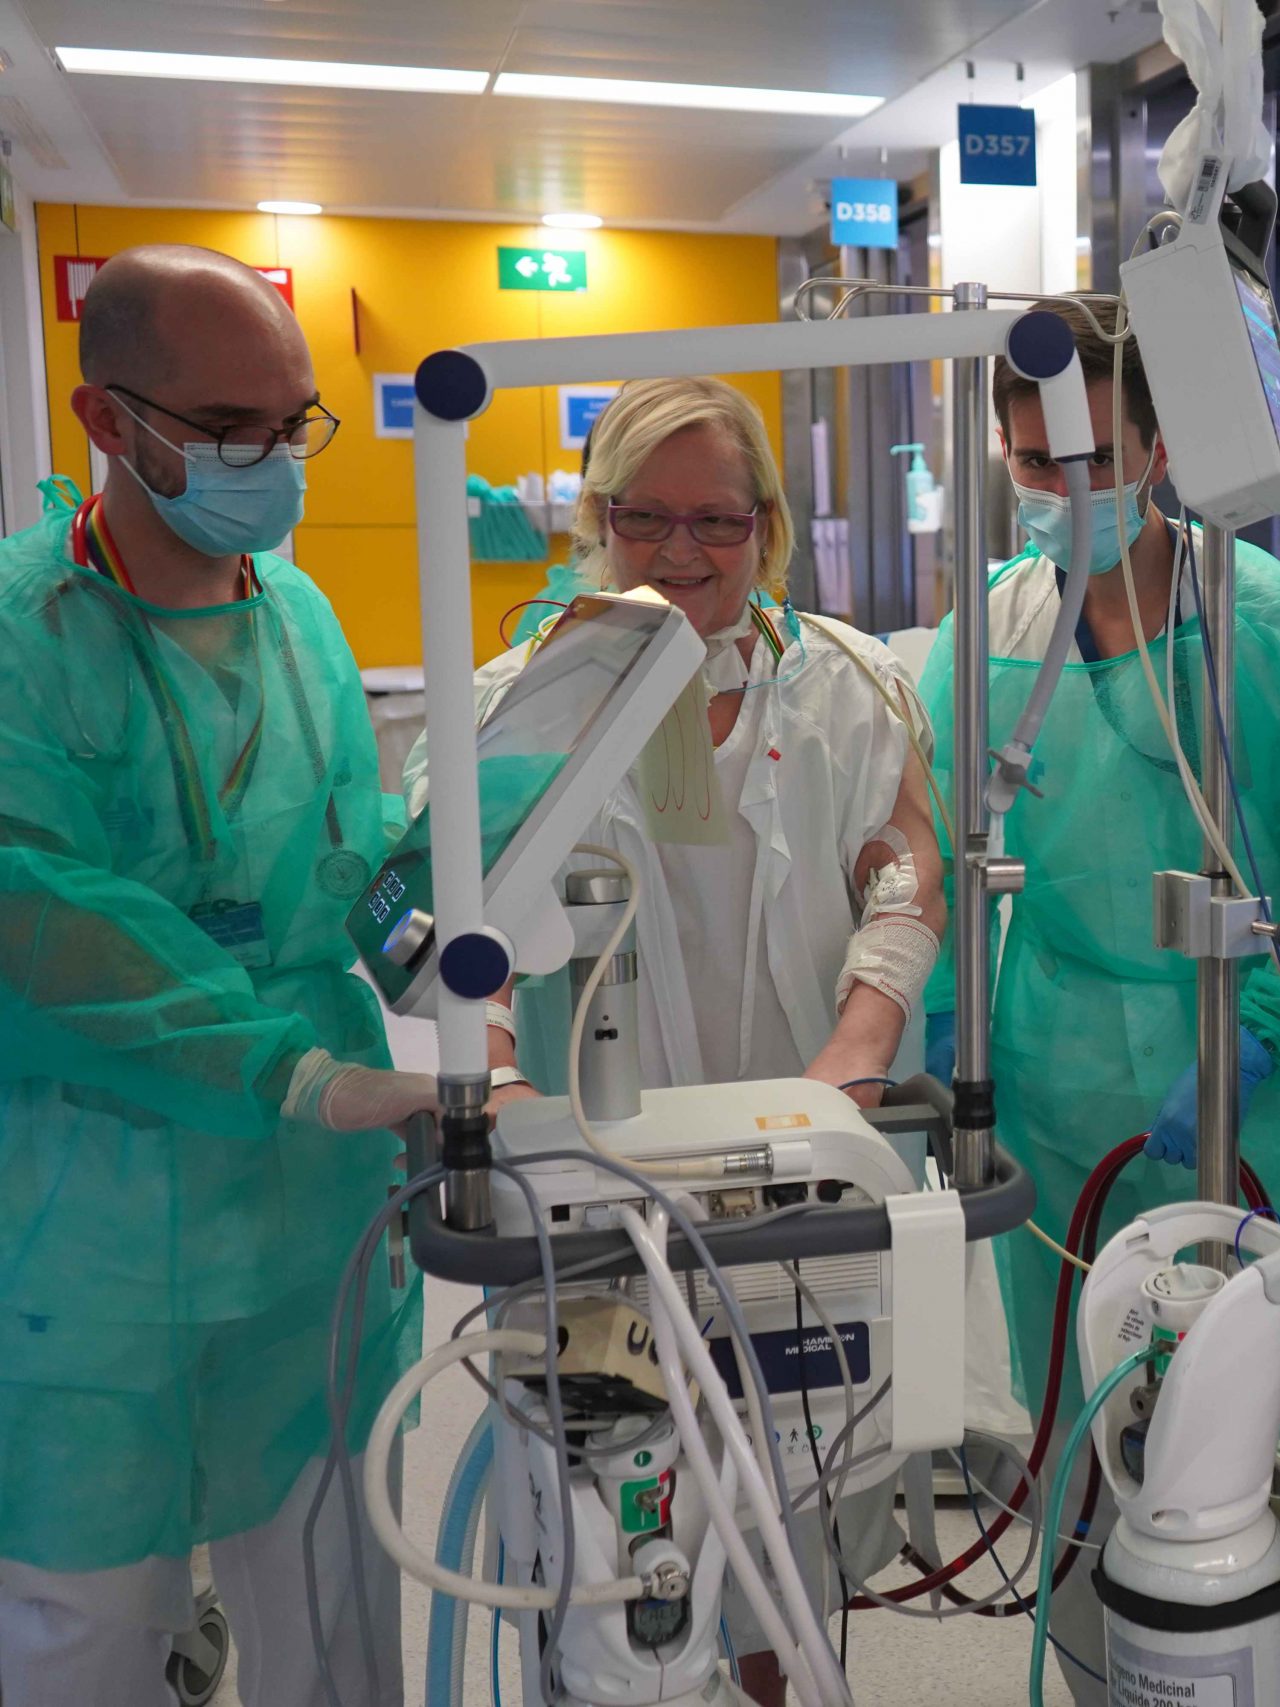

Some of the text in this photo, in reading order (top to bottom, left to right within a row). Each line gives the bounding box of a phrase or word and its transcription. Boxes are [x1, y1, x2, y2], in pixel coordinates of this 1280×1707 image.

[965, 134, 1030, 156] D357
[836, 202, 892, 223] D358
[1138, 1672, 1196, 1698] Medicinal
